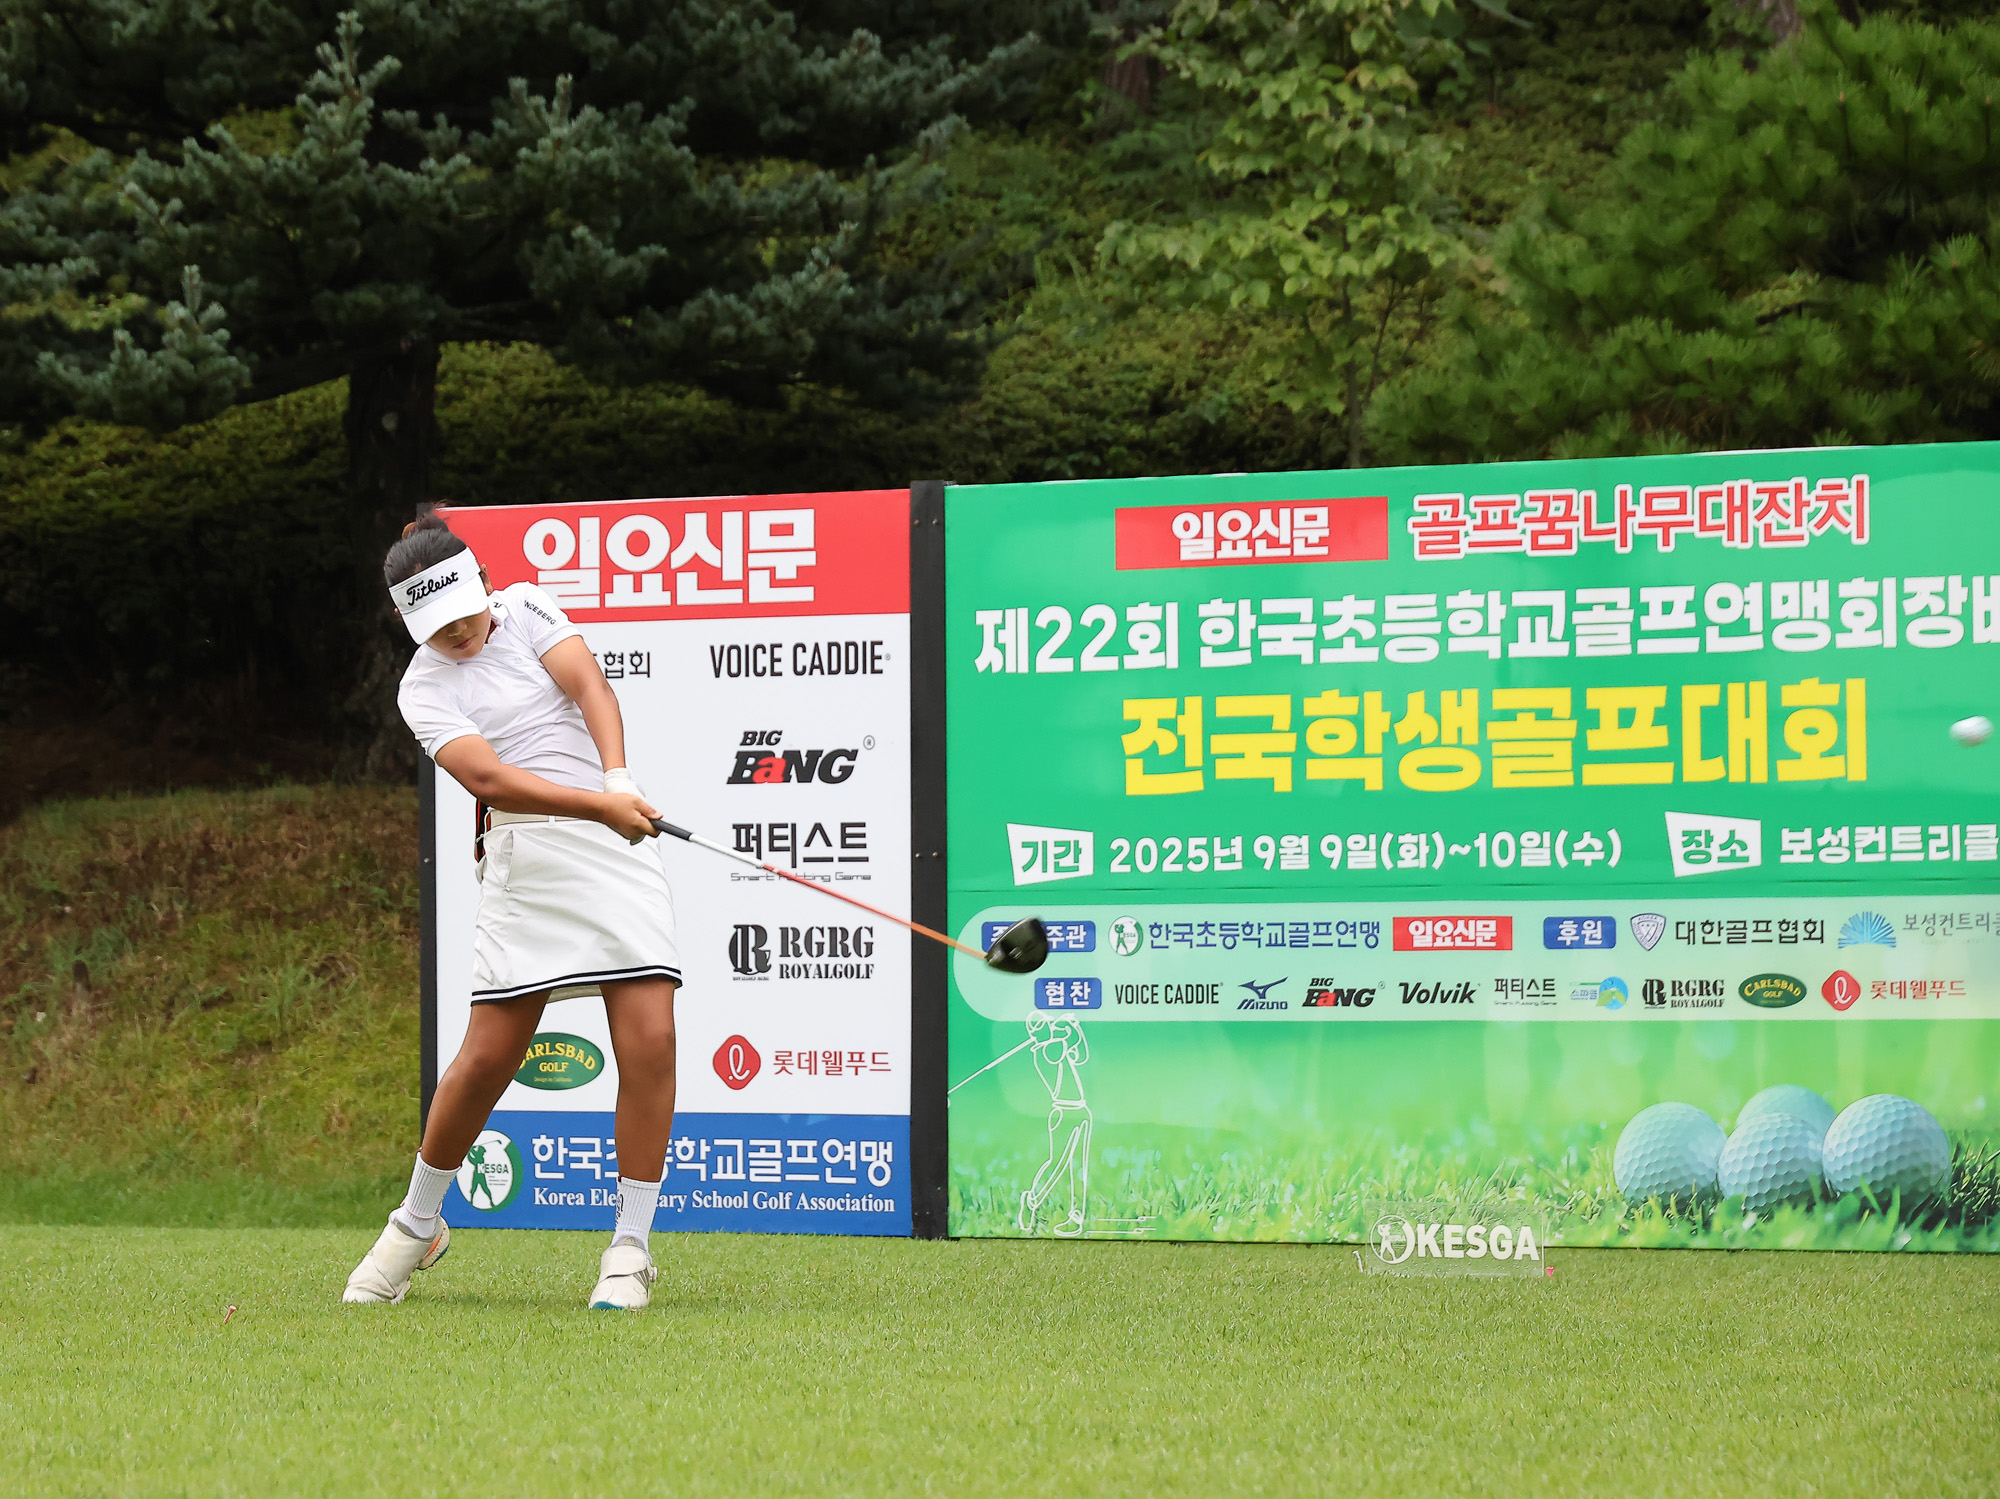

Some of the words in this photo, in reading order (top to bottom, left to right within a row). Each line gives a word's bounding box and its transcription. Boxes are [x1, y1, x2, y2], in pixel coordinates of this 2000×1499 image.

[1172, 506, 1330, 560] 일요신문
[1407, 474, 1871, 561] 골프꿈나무대잔치
[522, 508, 817, 609] 일요신문
[406, 571, 459, 606] Titleist
[974, 602, 1179, 673] 제22회
[592, 650, 650, 679] 협회
[710, 644, 783, 678] VOICE
[792, 640, 884, 677] CADDIE
[740, 730, 783, 746] BIG
[1121, 677, 1868, 795] 전국학생골프대회
[732, 822, 869, 869] 퍼티스트
[1021, 841, 1082, 873] 기간
[1109, 835, 1243, 873] 2025년
[1254, 833, 1310, 870] 9월
[1320, 828, 1622, 871] 9일(화)~10일(수)
[1681, 829, 1750, 864] 장소
[835, 872, 872, 881] Game
[779, 926, 874, 958] RGRG
[1149, 921, 1380, 950] 한국초등학교골프연맹
[1408, 919, 1498, 949] 일요신문
[1557, 918, 1604, 947] 후원
[1675, 918, 1825, 945] 대한골프협회
[779, 963, 874, 979] ROYALGOLF
[1310, 978, 1334, 986] BIG
[1045, 981, 1091, 1006] 협찬
[1115, 984, 1159, 1004] VOICE
[1164, 982, 1220, 1004] CADDIE
[1399, 982, 1477, 1004] Volvik
[1494, 978, 1556, 999] 퍼티스트
[1671, 979, 1725, 996] RGRG
[1744, 979, 1801, 997] CARLSBAD
[1871, 980, 1967, 1000] 롯데웰푸드
[1671, 998, 1725, 1008] ROYALGOLF
[539, 1062, 569, 1072] GOLF
[772, 1049, 892, 1077] 롯데웰푸드
[532, 1134, 893, 1187] 한국학교골프연맹
[533, 1187, 585, 1207] Korea
[590, 1188, 687, 1212] Eleary
[692, 1189, 749, 1210] School
[753, 1191, 793, 1211] Golf
[796, 1192, 895, 1212] Association
[1416, 1223, 1540, 1261] KESGA
